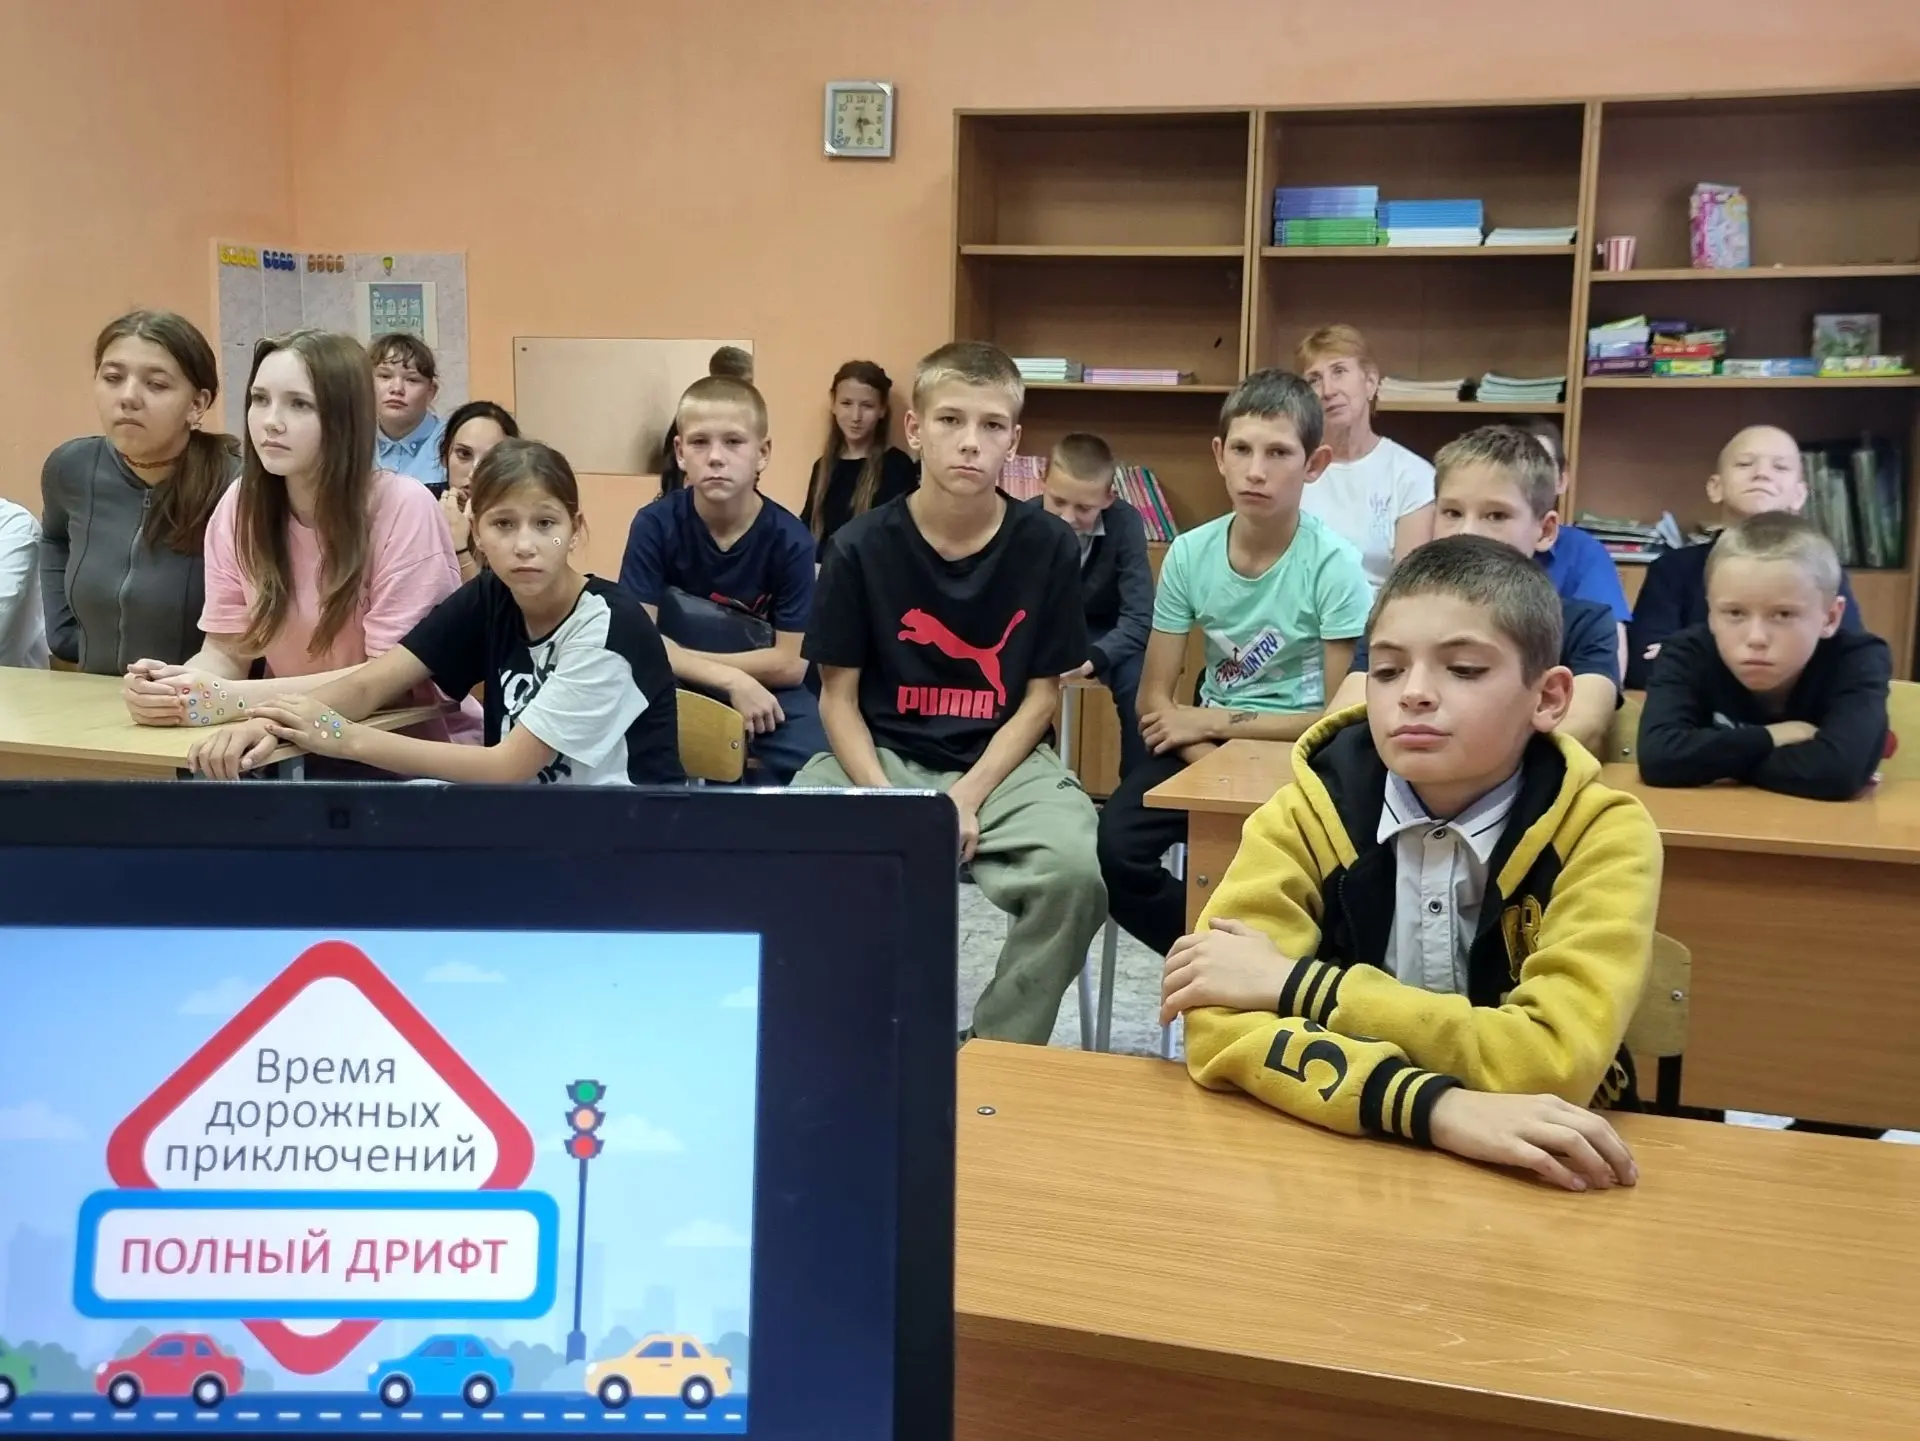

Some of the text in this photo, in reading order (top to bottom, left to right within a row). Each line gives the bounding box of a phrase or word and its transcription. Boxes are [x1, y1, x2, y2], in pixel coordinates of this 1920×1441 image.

[897, 686, 994, 719] PUMA
[256, 1048, 396, 1093] Время
[205, 1101, 441, 1137] дорожных
[165, 1134, 477, 1181] приключений
[121, 1228, 509, 1283] ПОЛНЫЙ ДРИФТ
